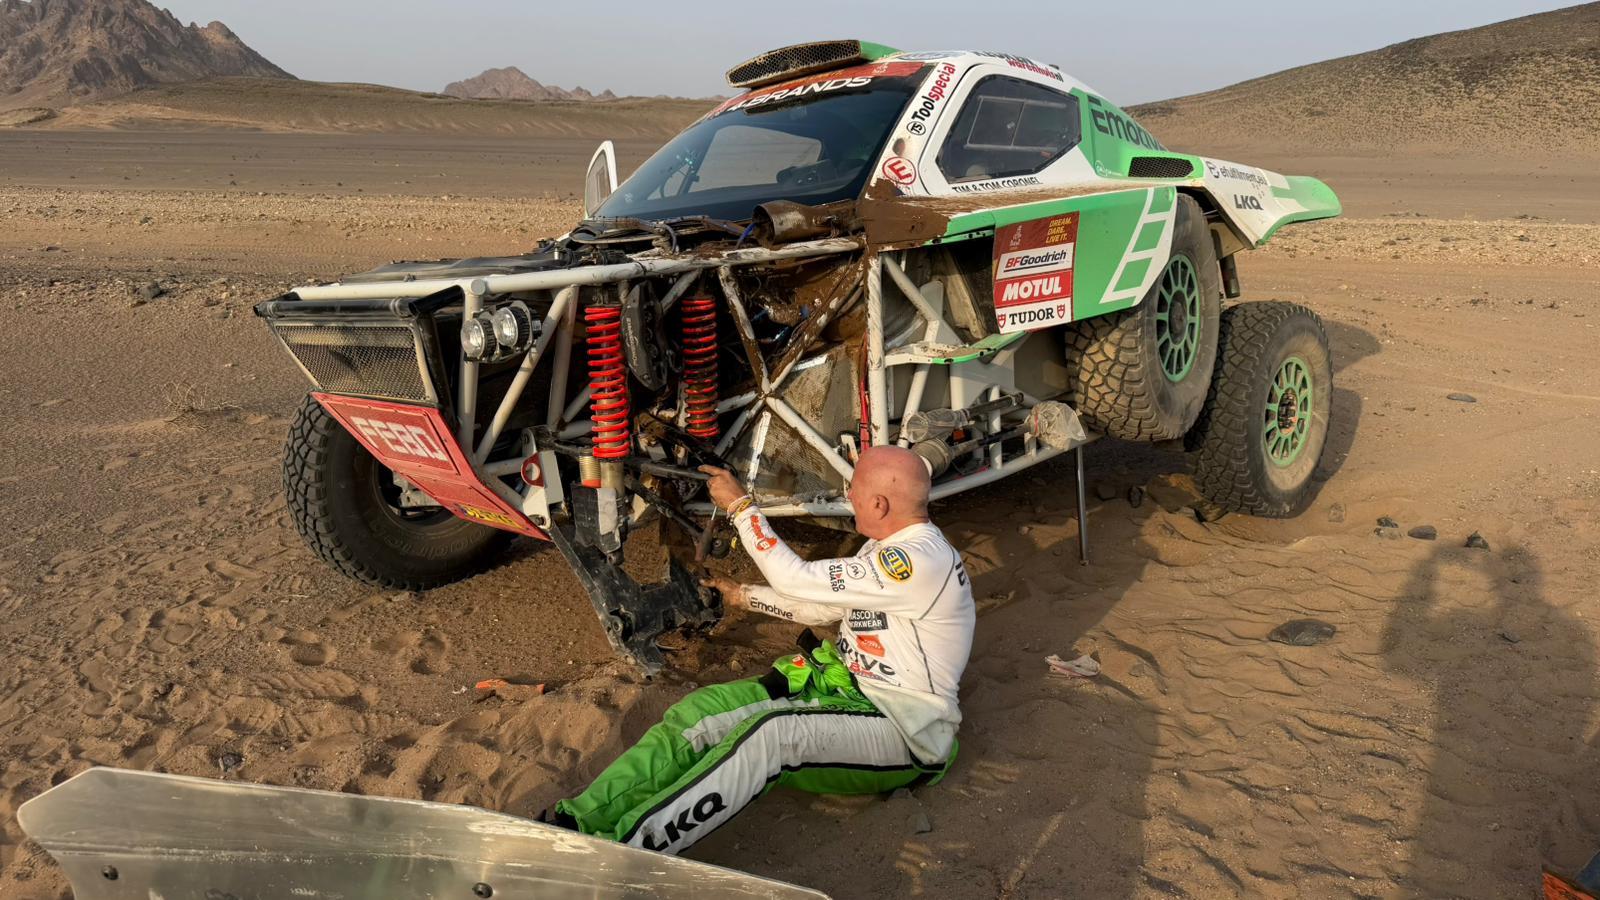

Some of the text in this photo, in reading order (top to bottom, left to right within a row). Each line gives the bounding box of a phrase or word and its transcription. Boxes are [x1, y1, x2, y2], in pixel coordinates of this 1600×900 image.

[912, 62, 956, 122] Toolspecial
[1233, 194, 1264, 210] LKQ
[1005, 249, 1067, 269] BFGoodrich
[1002, 276, 1062, 302] MOTUL
[1009, 308, 1055, 325] TUDOR
[828, 564, 839, 593] GUARD
[851, 619, 882, 628] ORKWEAR
[852, 610, 880, 620] ASCOT
[642, 792, 728, 851] LKQ
